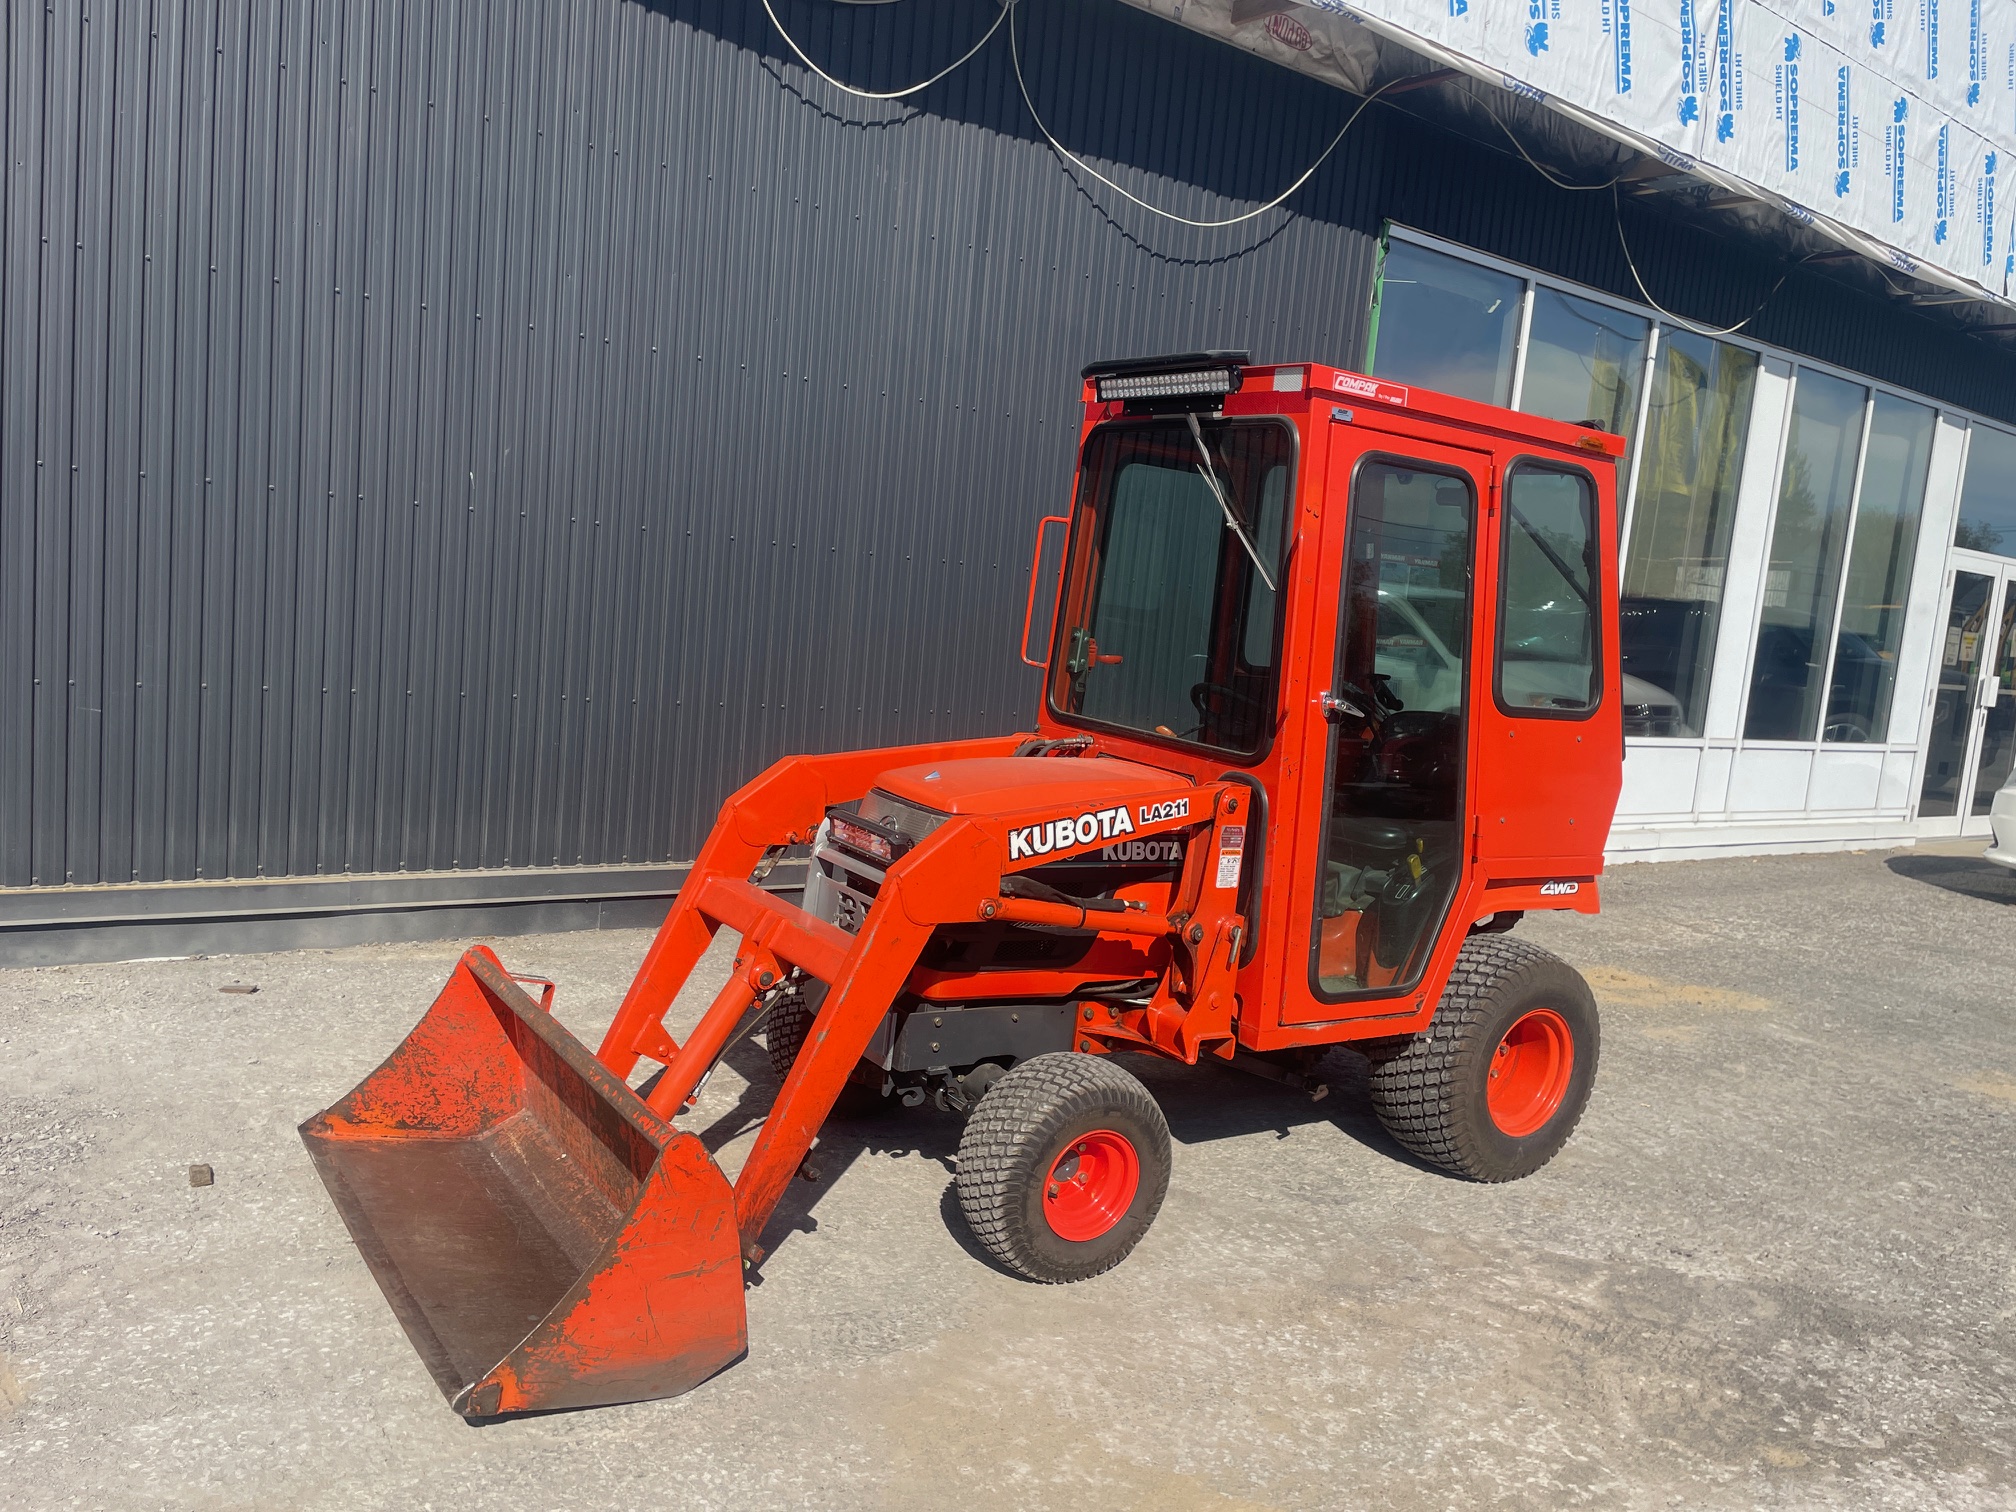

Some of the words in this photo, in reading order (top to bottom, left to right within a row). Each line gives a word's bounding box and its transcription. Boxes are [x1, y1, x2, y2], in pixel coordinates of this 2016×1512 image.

[1320, 3, 1366, 25] TITAN
[1620, 0, 1632, 94] PREMA
[1680, 0, 1692, 94] SOPREM
[1700, 33, 1707, 49] HT
[1931, 0, 1939, 80] OPREMA
[1969, 0, 1977, 81] SOPREM
[1698, 52, 1708, 93] SHIELD
[1735, 52, 1743, 72] HT
[1513, 82, 1546, 103] TITAN
[1735, 72, 1743, 111] SHIELD
[1775, 65, 1783, 103] SHIELD
[1775, 106, 1783, 121] HT
[1789, 64, 1799, 171] SOPREMA
[1837, 66, 1846, 169] SOPREMA
[1852, 115, 1859, 129] HT
[1663, 151, 1695, 171] TITAN
[1885, 163, 1892, 177] HT
[1896, 124, 1906, 222] SOPREMA
[1936, 124, 1947, 219] SOPREMA
[1985, 176, 1995, 266] SOPREMA
[1334, 375, 1379, 397] COMPAK
[1009, 805, 1135, 860] KUBOTA
[1139, 799, 1189, 825] LA211
[1102, 841, 1183, 861] KUBOTA
[1540, 880, 1579, 895] 4WD
